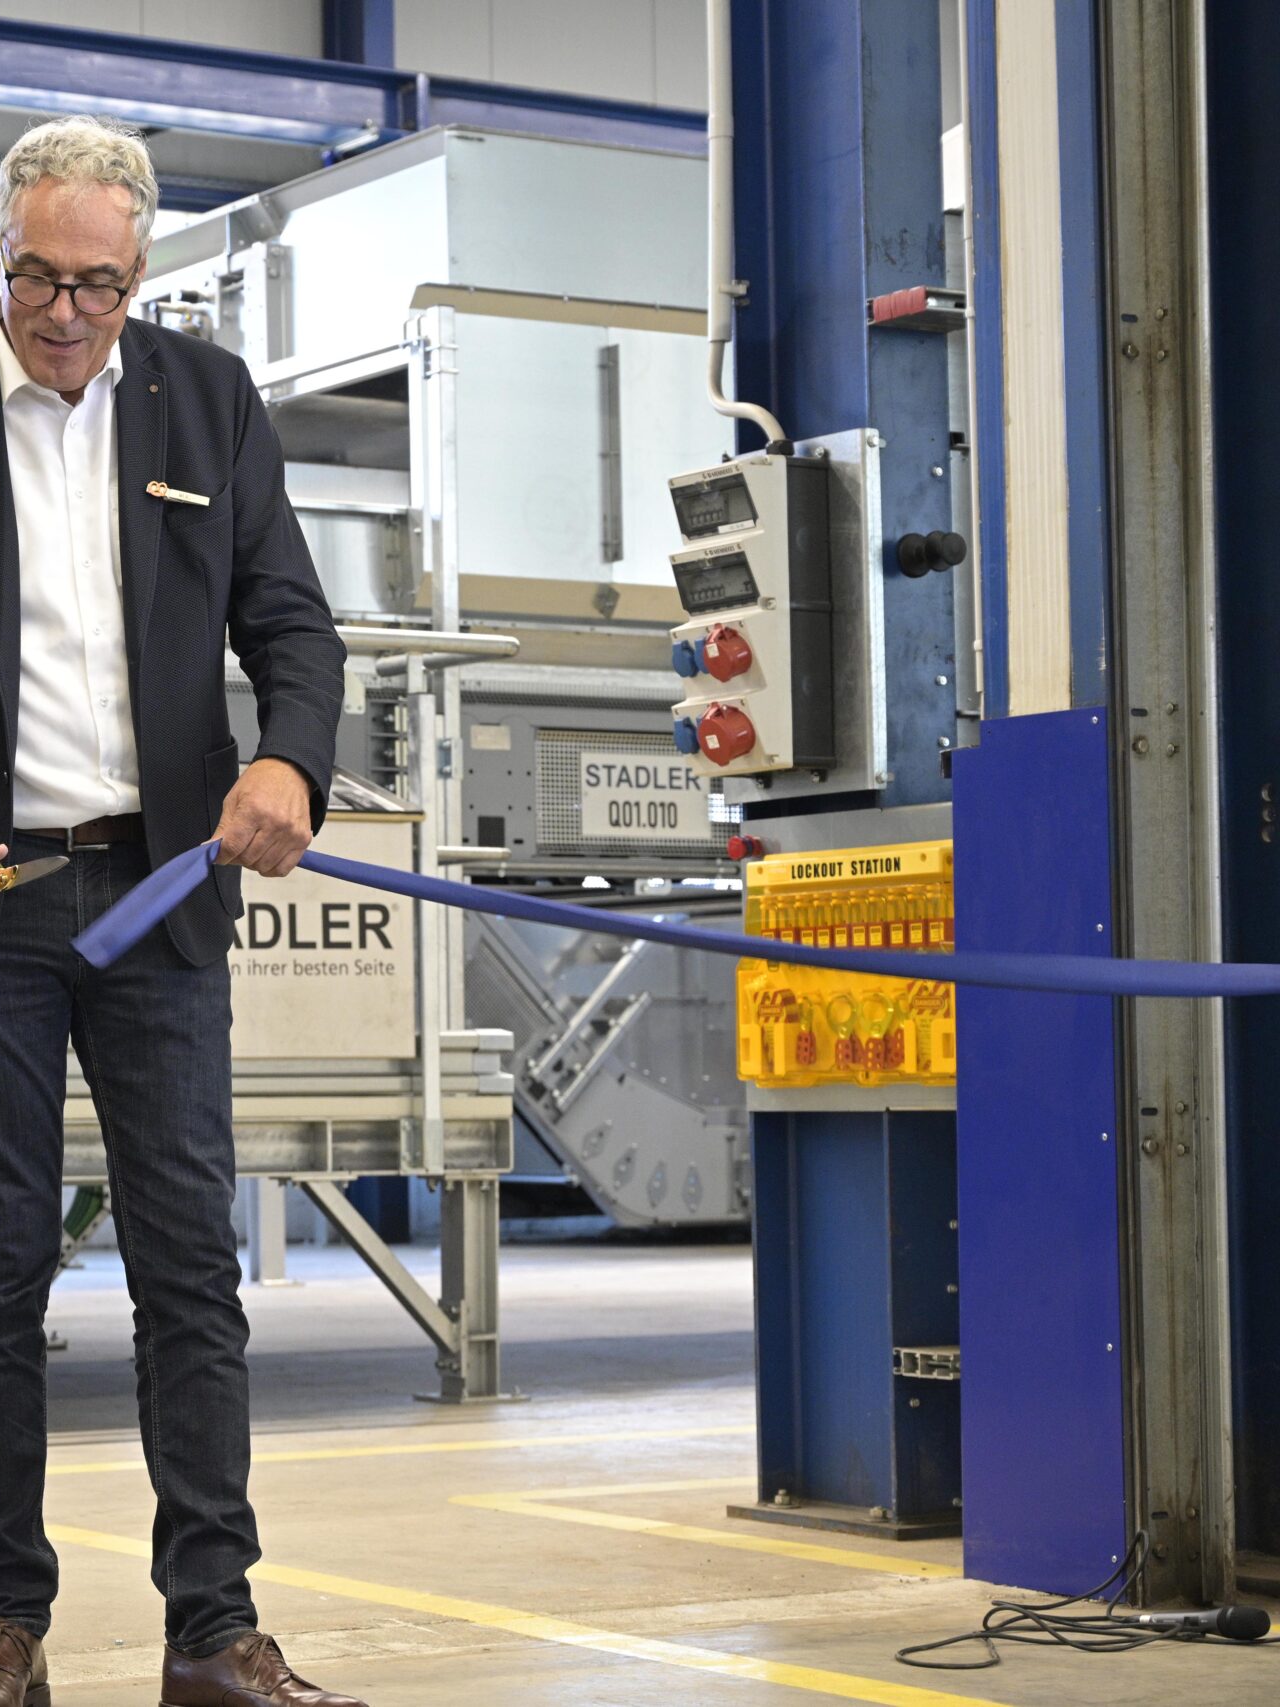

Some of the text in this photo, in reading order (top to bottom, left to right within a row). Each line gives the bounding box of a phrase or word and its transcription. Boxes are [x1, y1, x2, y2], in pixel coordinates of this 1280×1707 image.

[585, 764, 701, 791] STADLER
[609, 801, 678, 829] Q01.010
[791, 857, 901, 879] LOCKOUT STATION
[247, 959, 287, 976] ihrer
[293, 959, 349, 976] besten
[354, 959, 396, 976] Seite
